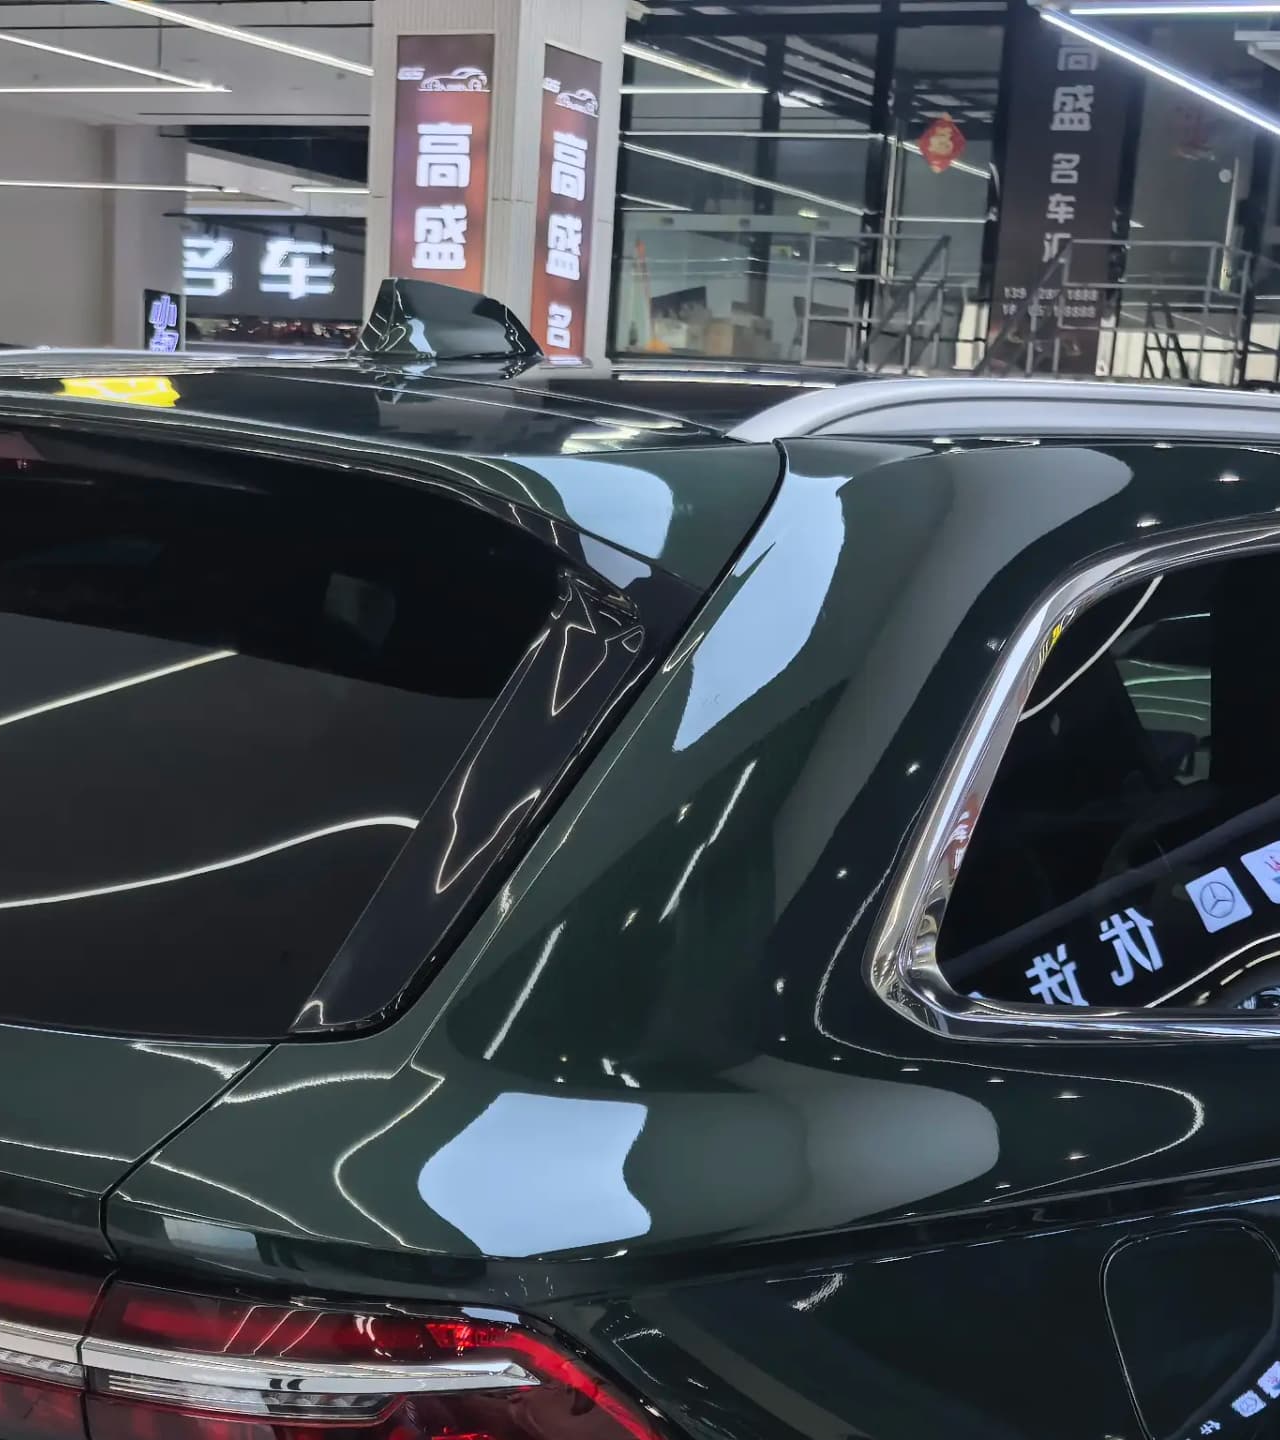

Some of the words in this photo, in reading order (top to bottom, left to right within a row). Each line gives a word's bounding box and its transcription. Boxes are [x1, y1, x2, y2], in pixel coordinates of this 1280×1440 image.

[411, 122, 473, 270] 高盛
[545, 131, 589, 364] 高盛名
